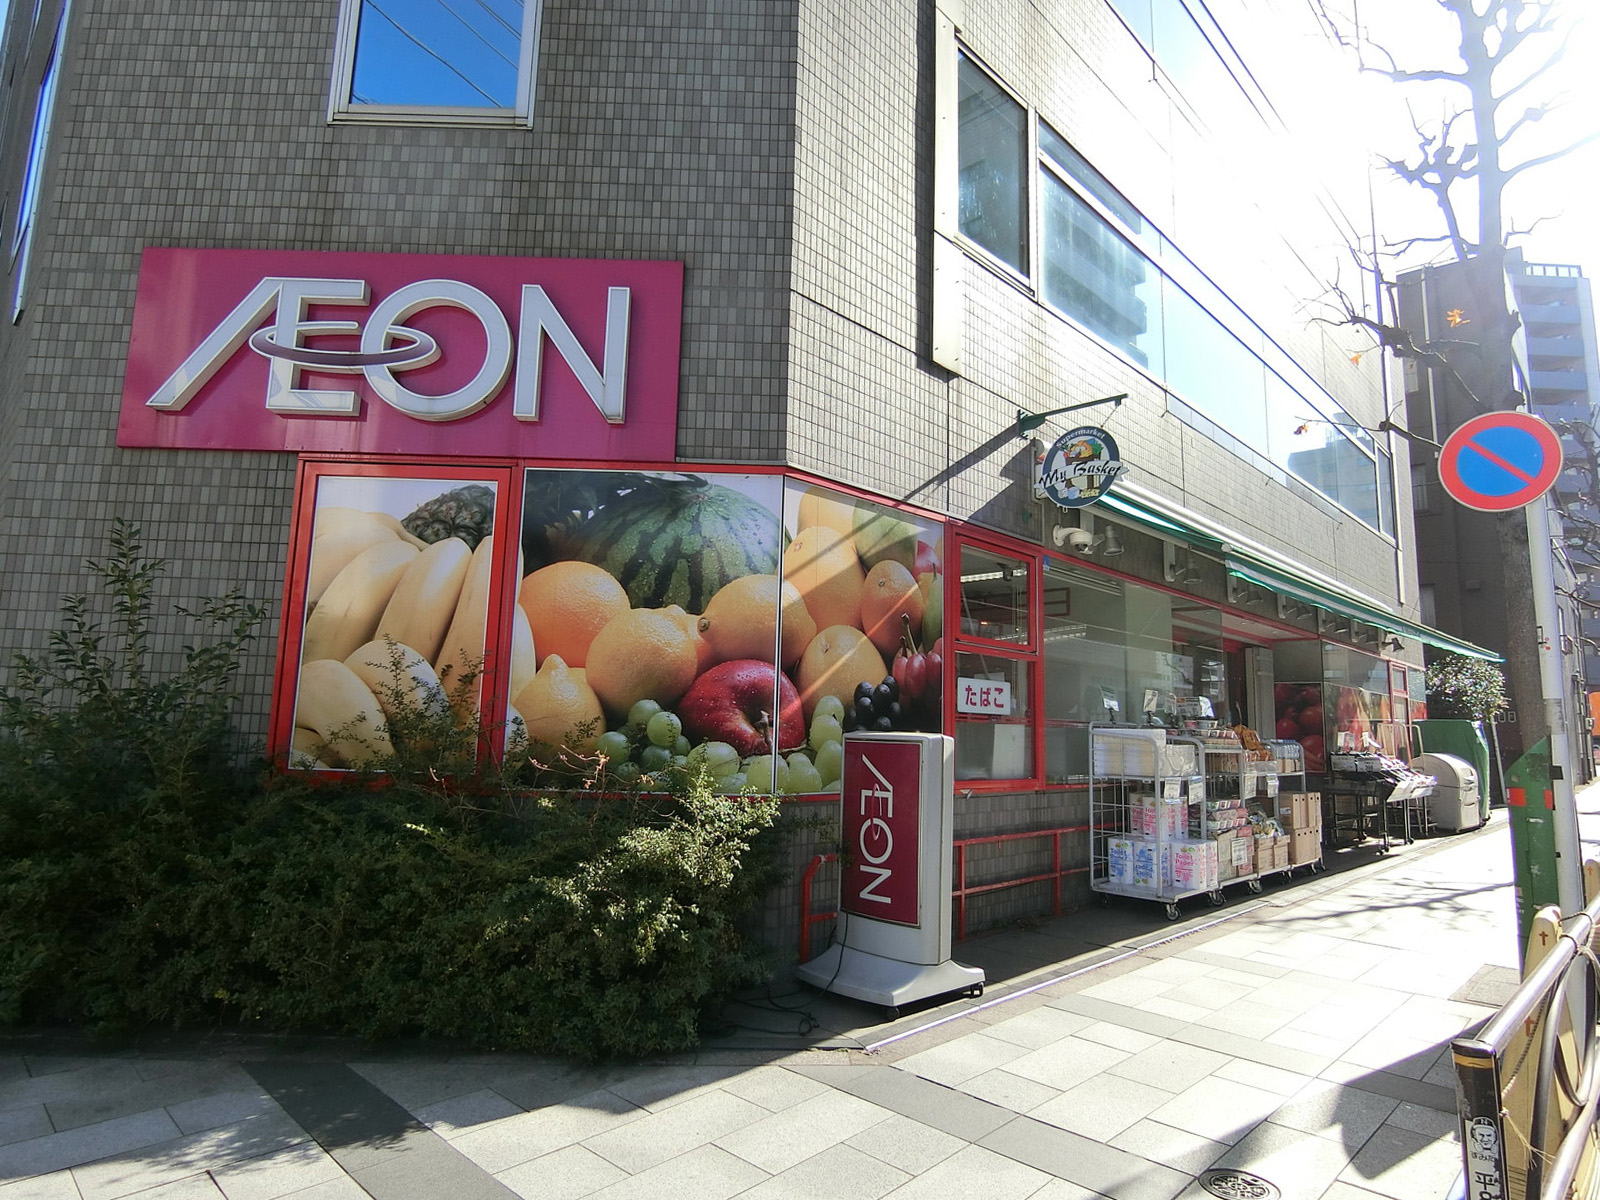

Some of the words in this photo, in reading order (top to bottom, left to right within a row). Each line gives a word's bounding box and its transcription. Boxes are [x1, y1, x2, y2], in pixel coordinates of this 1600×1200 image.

[1039, 468, 1067, 489] My
[1073, 460, 1122, 476] Basket
[965, 684, 1005, 709] たばこ
[1174, 852, 1193, 861] Toilet
[1175, 858, 1194, 867] Paper
